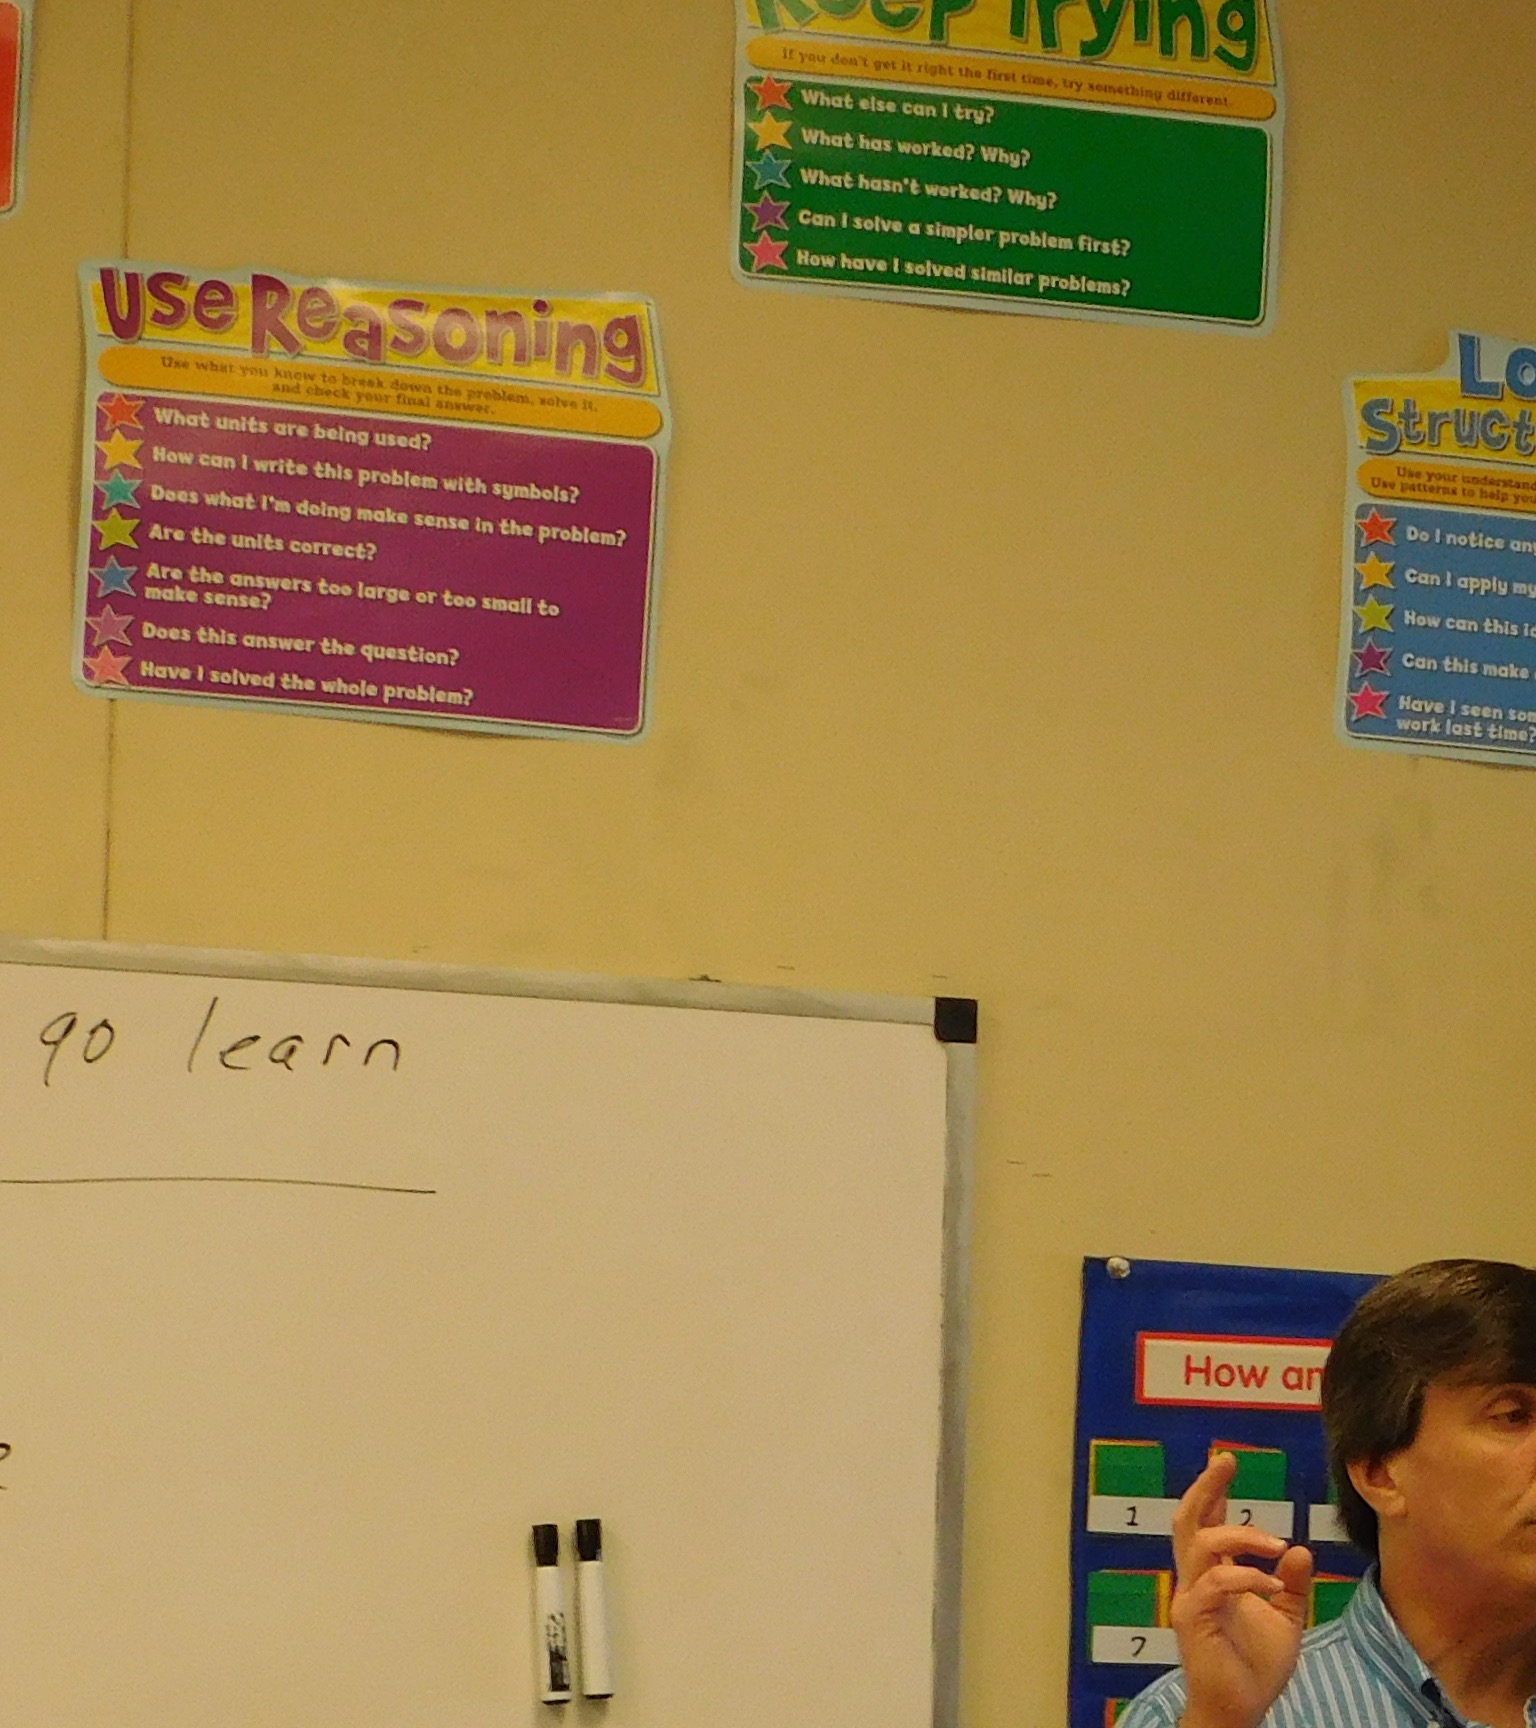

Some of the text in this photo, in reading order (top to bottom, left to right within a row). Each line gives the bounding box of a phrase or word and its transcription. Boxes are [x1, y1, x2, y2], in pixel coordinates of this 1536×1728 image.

[799, 88, 853, 109] What
[858, 95, 896, 112] else
[901, 101, 937, 117] can
[953, 103, 994, 125] try?
[800, 126, 1030, 168] What has worked? Why?
[799, 167, 1057, 211] What hasn't worked? Why?
[795, 248, 836, 268] How
[839, 252, 887, 272] have
[903, 259, 966, 280] solved
[970, 265, 1034, 285] similar
[1037, 273, 1130, 296] problems?
[100, 267, 646, 386] Use Reasoning
[153, 406, 432, 450] What units are being used?
[151, 444, 195, 465] How
[197, 452, 236, 470] can
[252, 458, 308, 476] write
[312, 460, 353, 480] this
[357, 468, 438, 489] problem
[441, 476, 487, 494] with
[491, 482, 580, 503] symbols?
[148, 522, 377, 560] Are the units correct?
[1405, 524, 1430, 542] Do
[1445, 530, 1505, 549] notice
[1403, 609, 1441, 628] How
[1444, 616, 1479, 632] can
[1482, 617, 1519, 636] this
[141, 620, 459, 666] Does this answer the question?
[139, 659, 191, 680] Have
[209, 668, 275, 689] solved
[279, 672, 315, 691] the
[320, 677, 378, 697] whole
[382, 684, 473, 706] problem?
[1401, 652, 1437, 670] Can
[1441, 655, 1478, 674] this
[1481, 662, 1529, 679] make
[187, 997, 400, 1072] learn
[1184, 1354, 1269, 1388] How
[1125, 1506, 1139, 1526] 1
[1239, 1509, 1254, 1526] 2
[1131, 1636, 1147, 1657] 7
